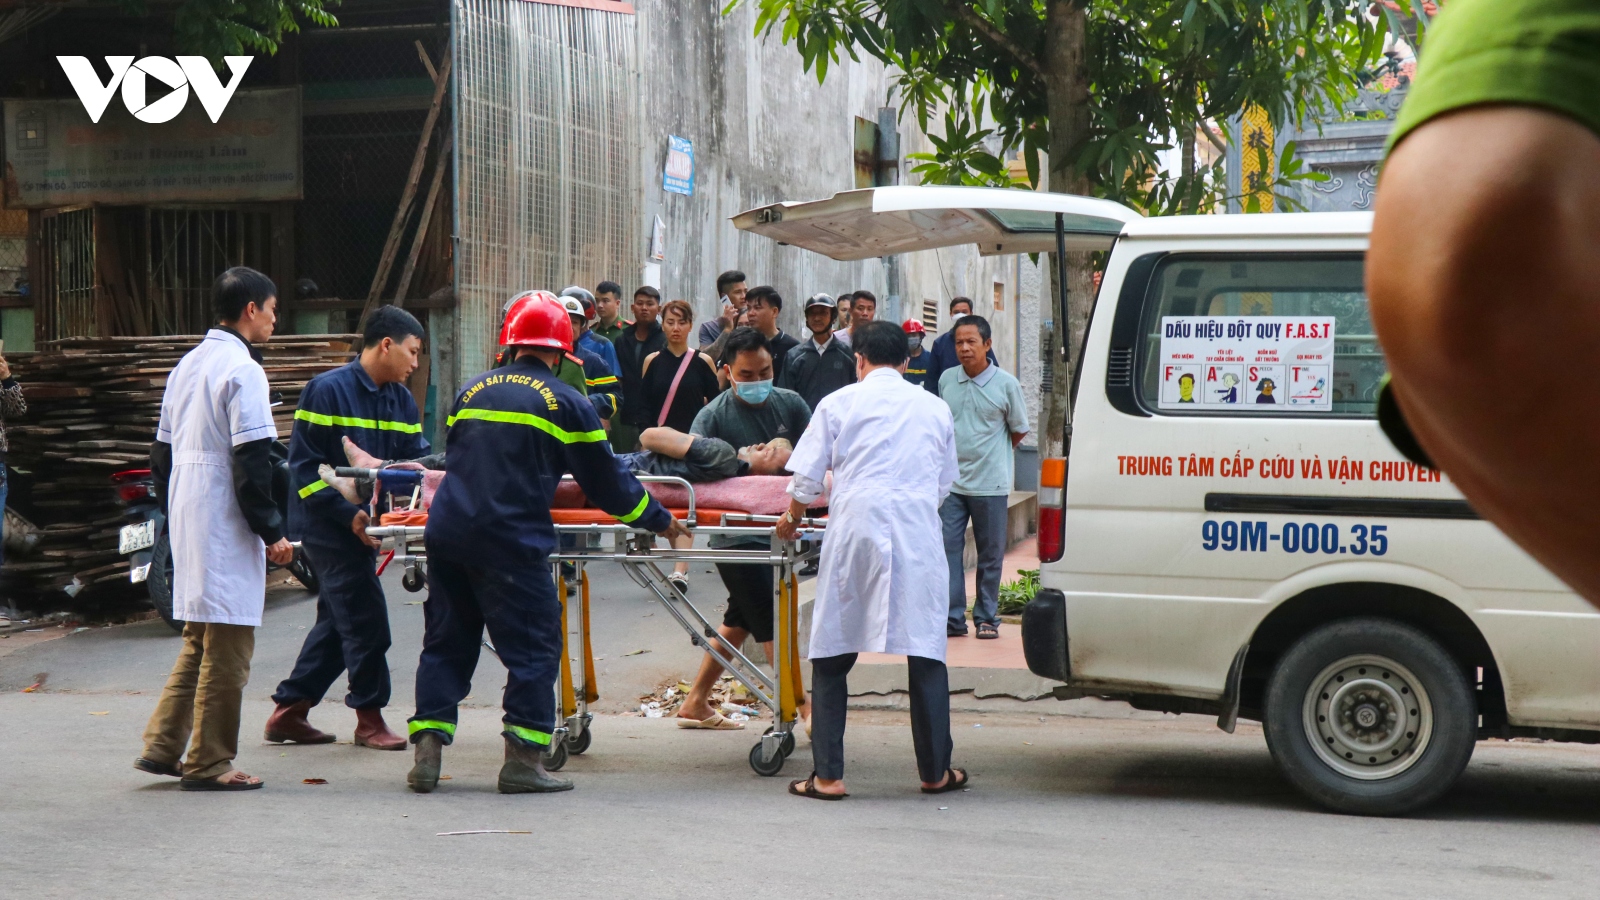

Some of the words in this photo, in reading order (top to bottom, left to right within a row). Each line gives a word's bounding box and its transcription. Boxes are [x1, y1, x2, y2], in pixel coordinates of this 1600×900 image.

[1165, 320, 1191, 338] DẤU
[1195, 320, 1224, 341] HIỆU
[1227, 320, 1253, 341] ĐỘT
[1256, 323, 1282, 341] QUỴ
[1285, 323, 1331, 338] F.A.S.T
[506, 374, 532, 385] PCCC
[540, 387, 559, 411] CNCH
[1117, 456, 1173, 476] TRUNG
[1178, 453, 1214, 477] TÂM
[1220, 450, 1254, 478] CẤP
[1259, 454, 1295, 479] CỨU
[1300, 454, 1323, 479] VÀ
[1328, 456, 1363, 485] VẬN
[1202, 520, 1388, 556] 99M-000.35
